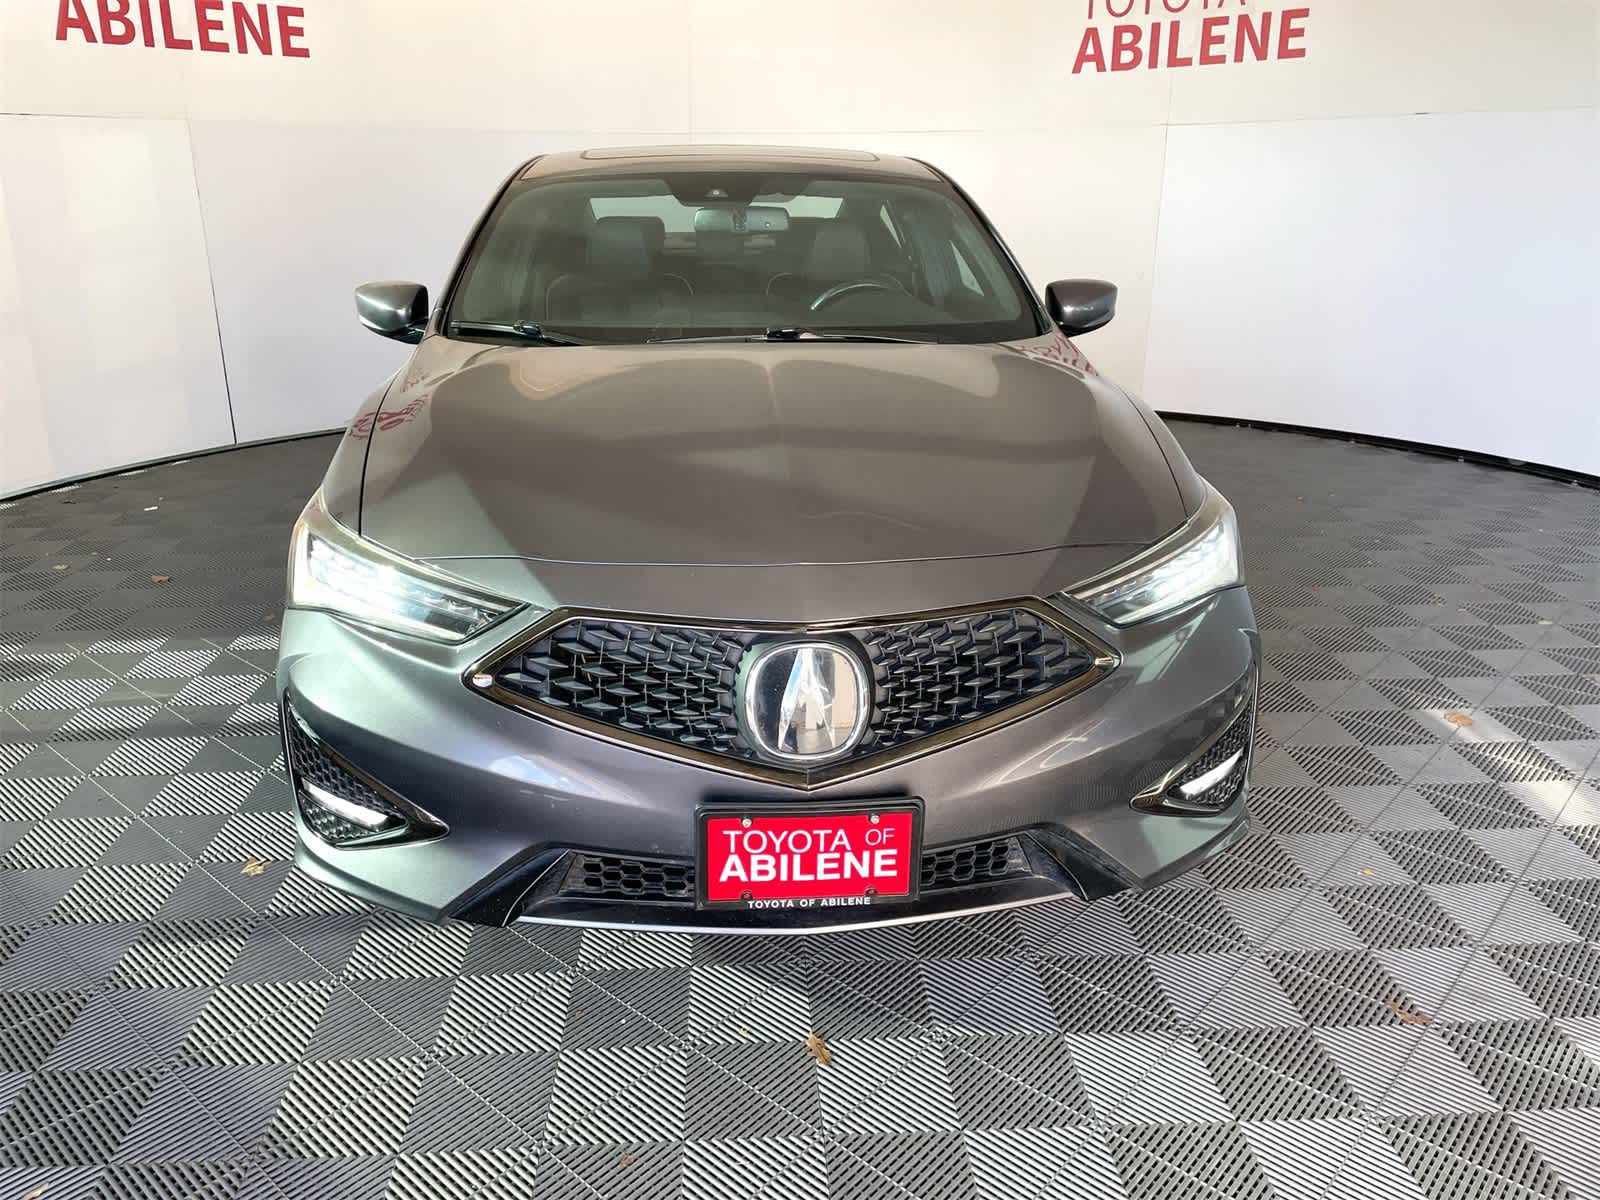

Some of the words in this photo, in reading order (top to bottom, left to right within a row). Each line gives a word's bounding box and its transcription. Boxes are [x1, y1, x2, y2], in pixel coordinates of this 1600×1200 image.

[55, 0, 310, 58] ABILENE
[1071, 7, 1310, 74] ABILENE
[722, 829, 852, 854] TOYOTA
[864, 827, 896, 846] OF
[718, 849, 898, 882] ABILENE
[747, 899, 795, 909] TOYOTA
[799, 898, 816, 908] OF
[820, 896, 871, 907] ABILENE
